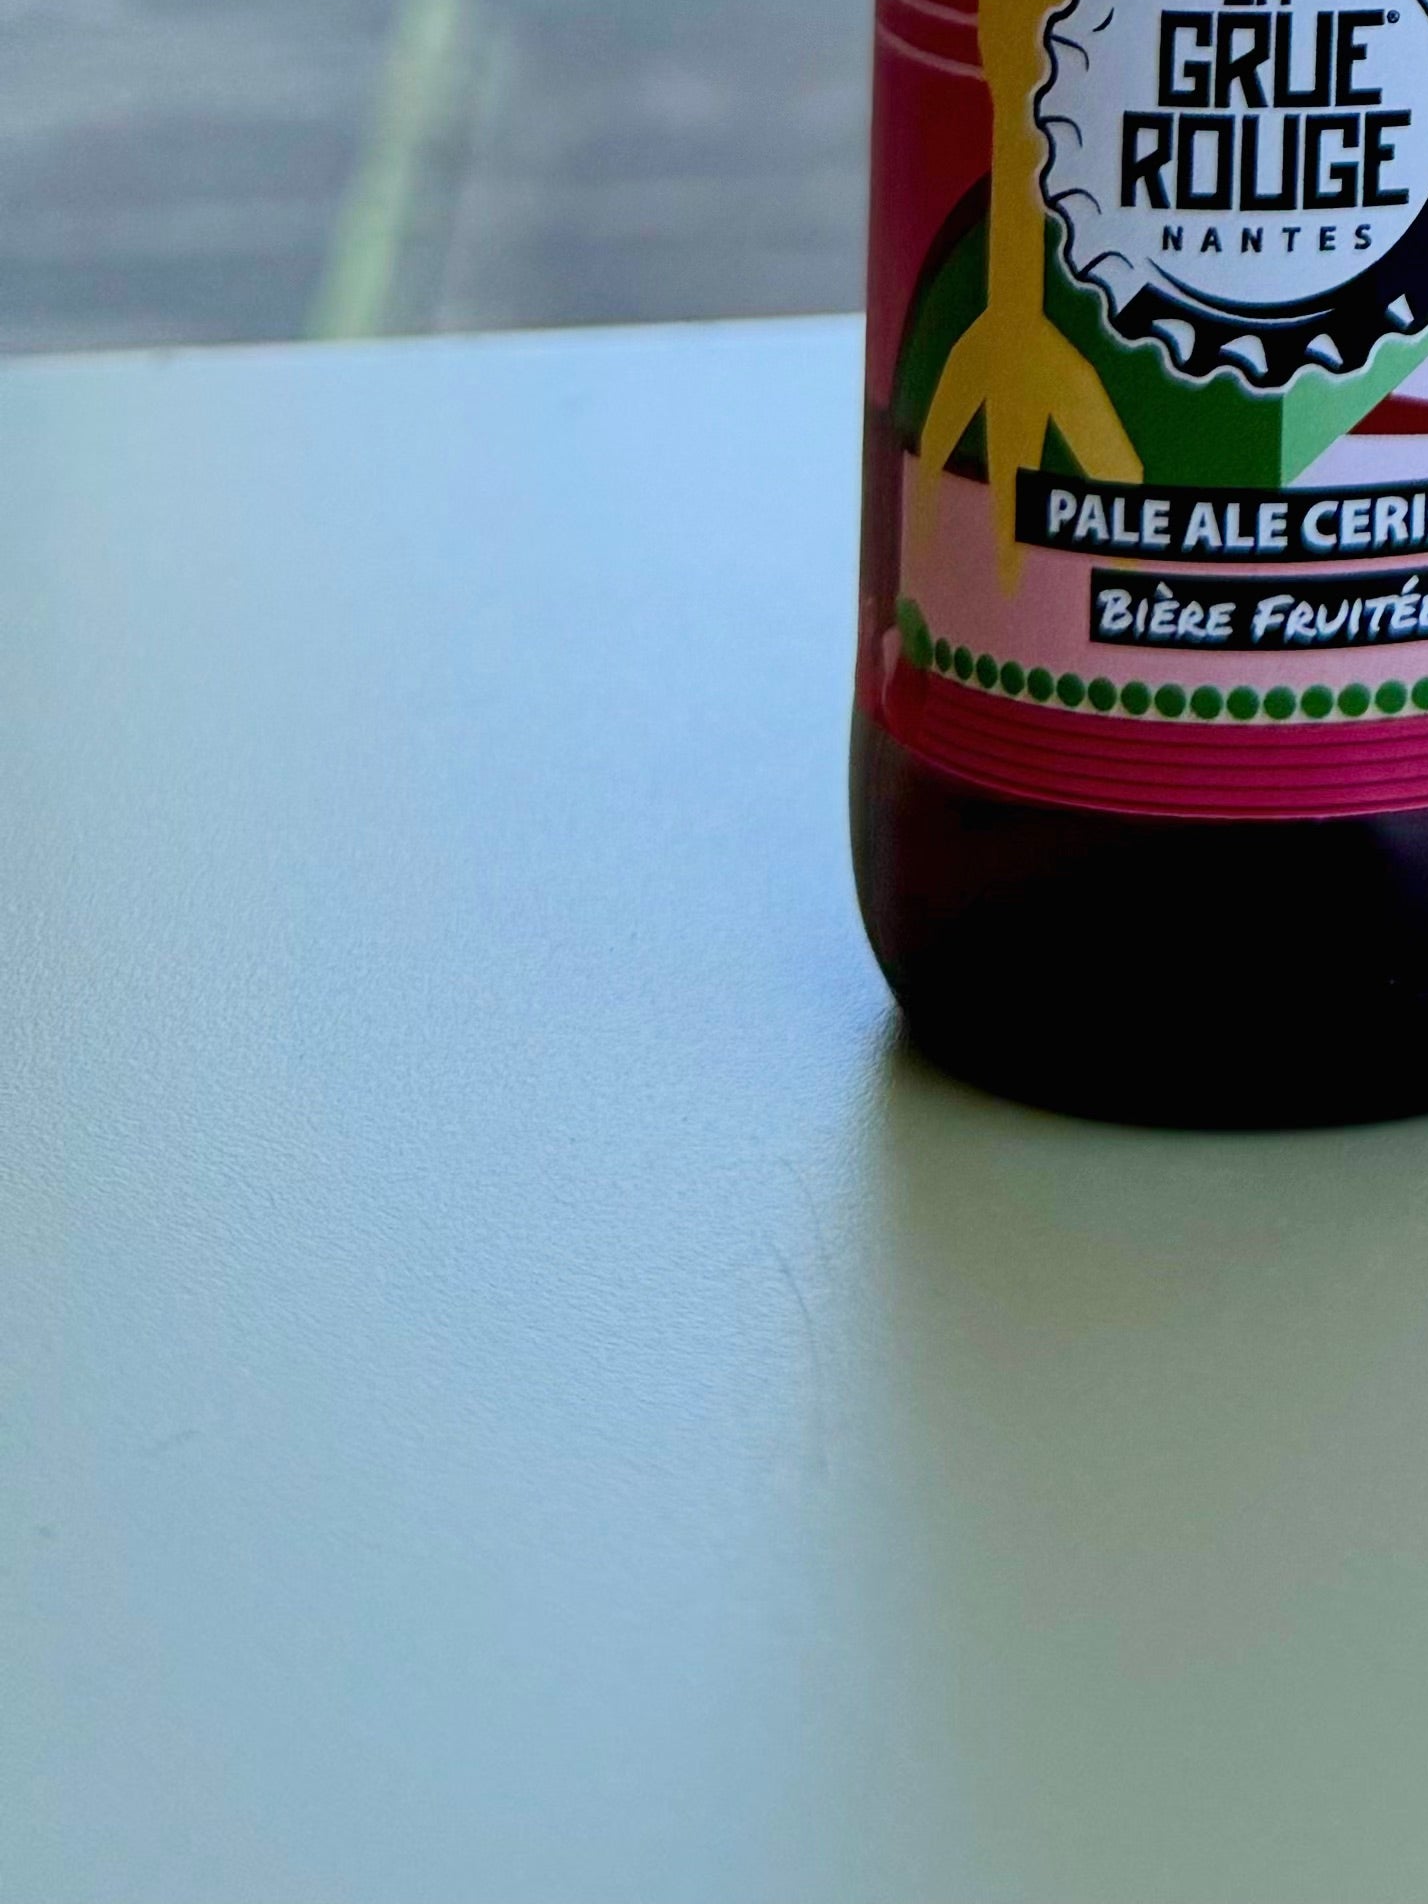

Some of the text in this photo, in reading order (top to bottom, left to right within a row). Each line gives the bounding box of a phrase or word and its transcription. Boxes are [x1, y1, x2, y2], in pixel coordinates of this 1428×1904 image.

[1120, 109, 1413, 212] ROUGE
[1161, 223, 1374, 255] NANTES
[1046, 488, 1172, 550] PALE
[1181, 500, 1290, 552] ALE
